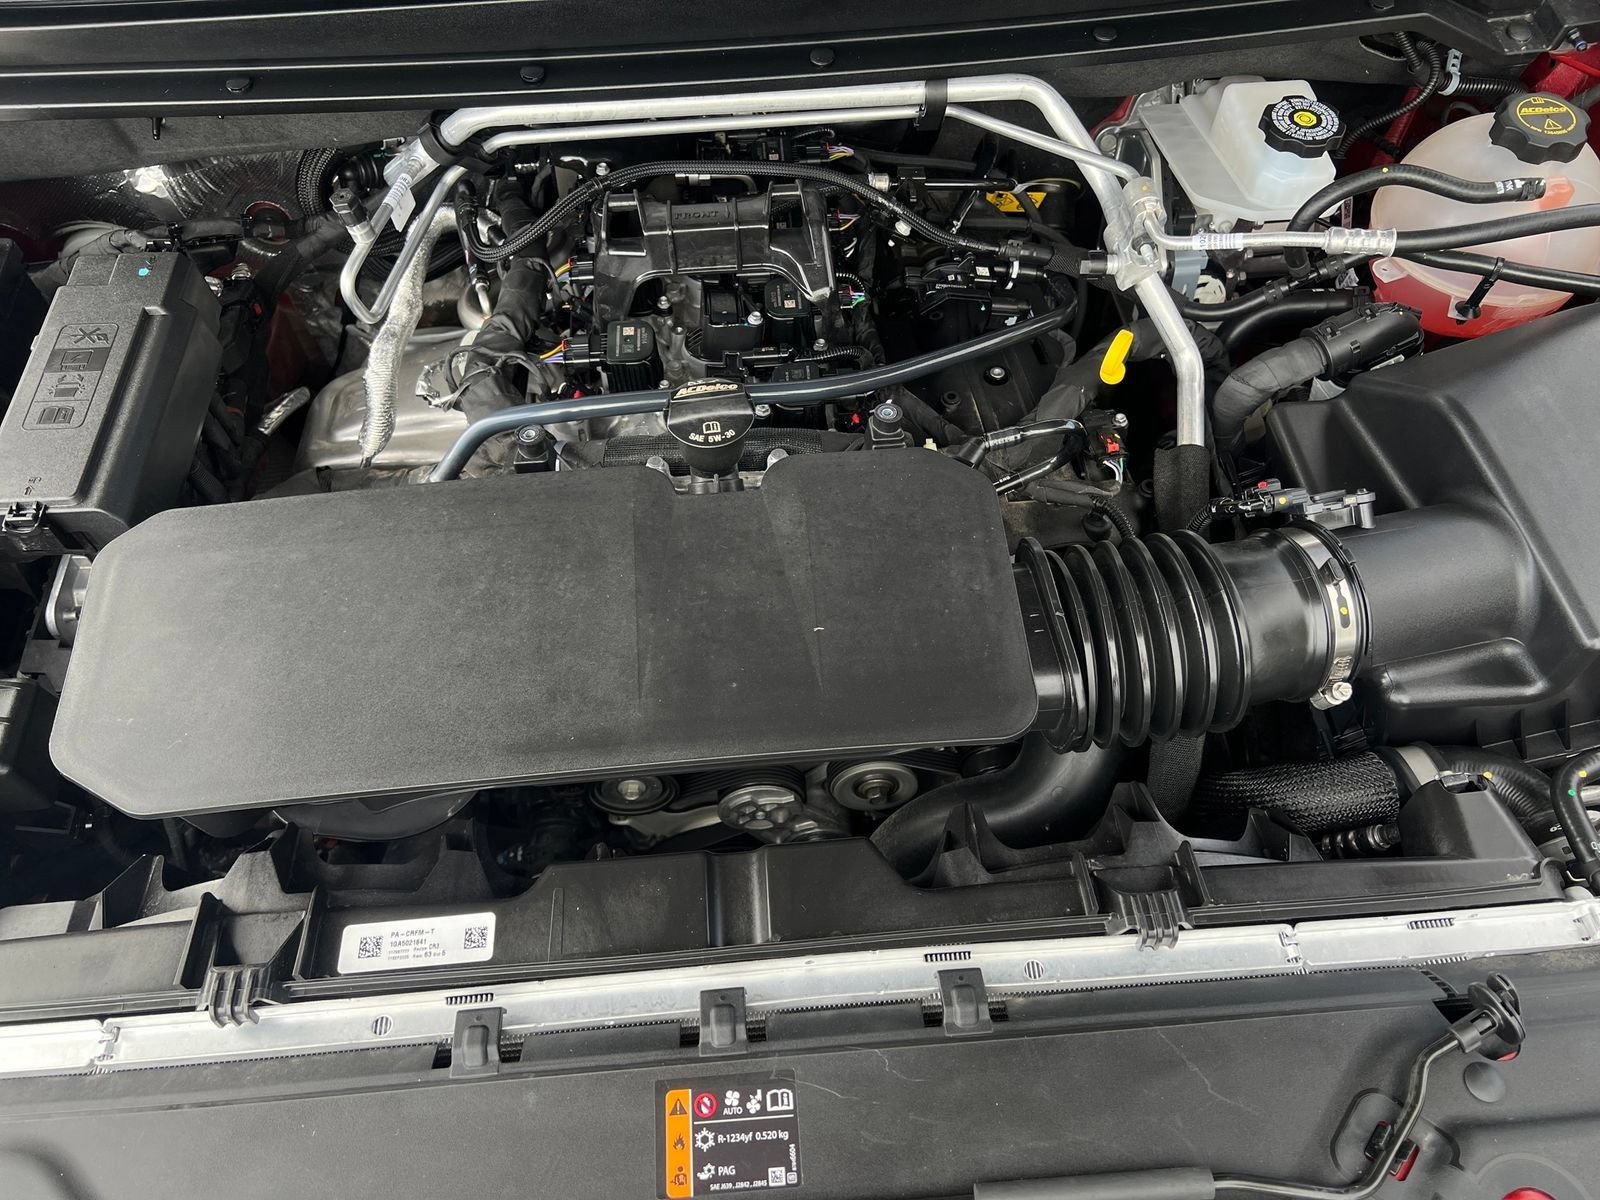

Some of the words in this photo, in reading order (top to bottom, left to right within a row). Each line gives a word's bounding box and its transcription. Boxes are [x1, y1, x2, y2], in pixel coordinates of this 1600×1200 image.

[1521, 106, 1567, 114] ACDelco
[675, 210, 719, 220] FRONT
[676, 383, 738, 396] ACDelco
[688, 432, 705, 443] SAE
[708, 429, 736, 443] 5W-30
[723, 1106, 743, 1116] AUTO
[717, 1131, 753, 1144] R-1234yf
[755, 1130, 777, 1141] 0.520
[778, 1130, 789, 1141] kg
[718, 1165, 736, 1176] PAG
[710, 1183, 720, 1191] SAE
